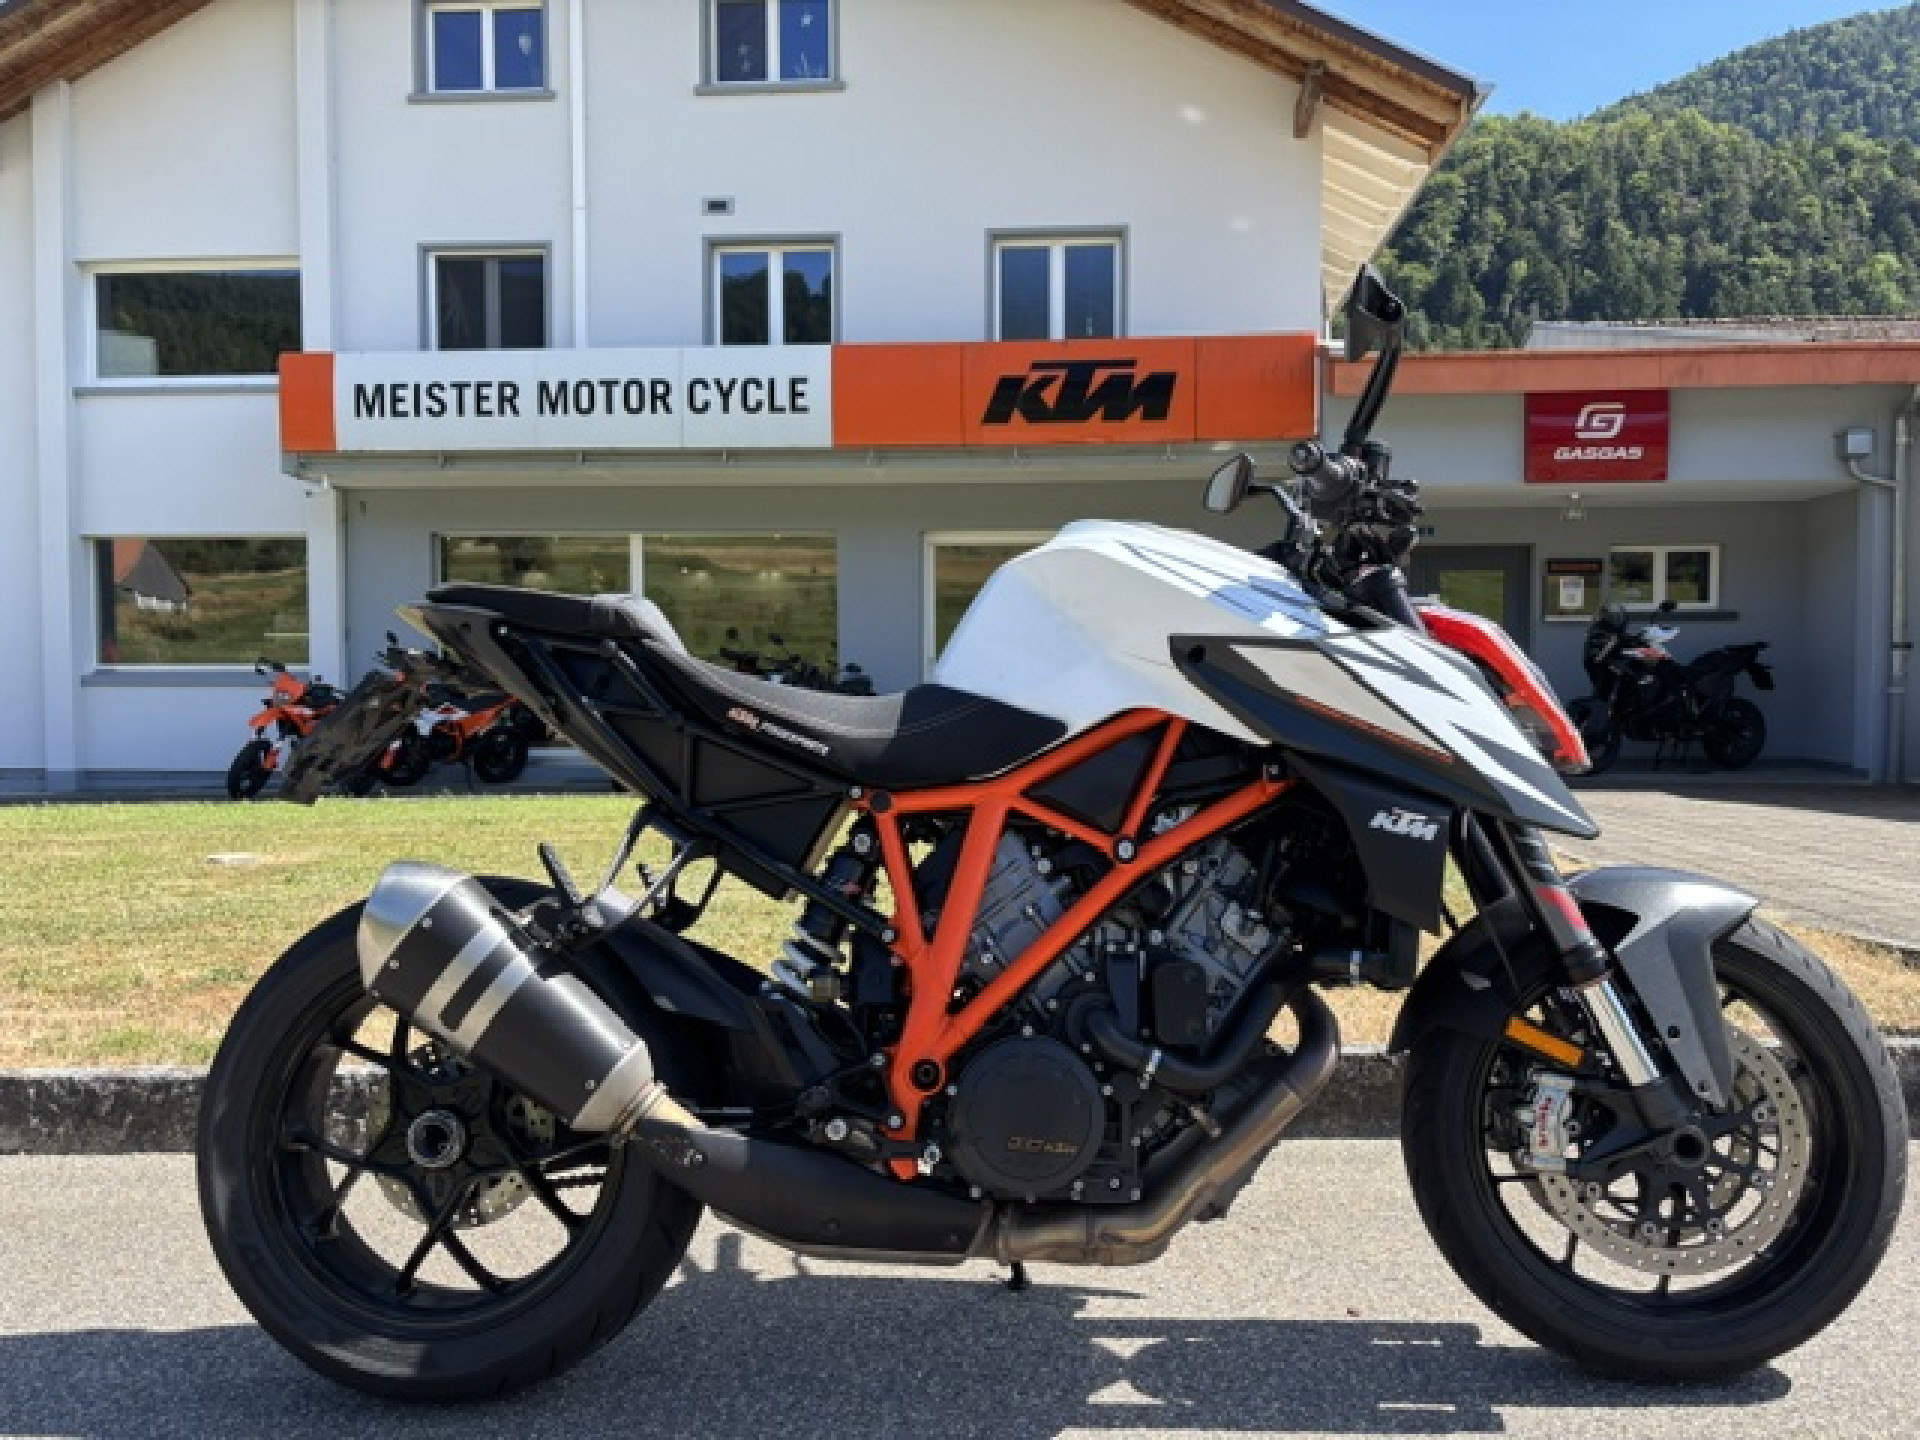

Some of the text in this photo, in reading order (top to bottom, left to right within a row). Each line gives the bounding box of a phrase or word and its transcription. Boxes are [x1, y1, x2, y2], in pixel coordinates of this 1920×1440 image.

[353, 377, 809, 418] MEISTER MOTOR CYCLE
[981, 358, 1177, 424] KTM
[1553, 446, 1644, 460] GASGAS
[1368, 806, 1440, 841] KTM
